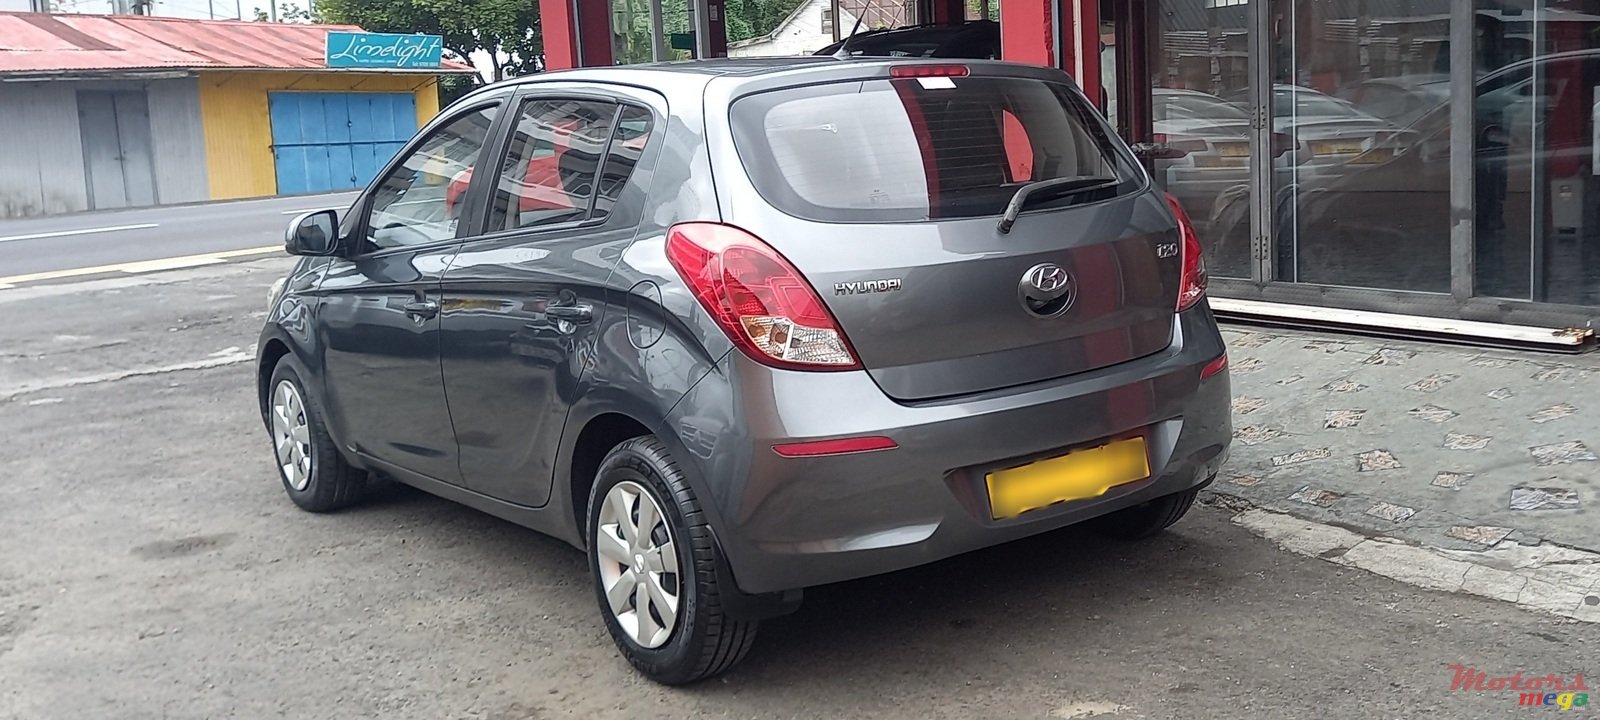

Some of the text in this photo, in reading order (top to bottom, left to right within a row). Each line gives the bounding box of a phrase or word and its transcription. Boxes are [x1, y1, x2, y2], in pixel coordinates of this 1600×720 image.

[330, 35, 440, 67] Limelight
[1156, 242, 1178, 258] i20
[834, 278, 902, 295] HYUNDAI
